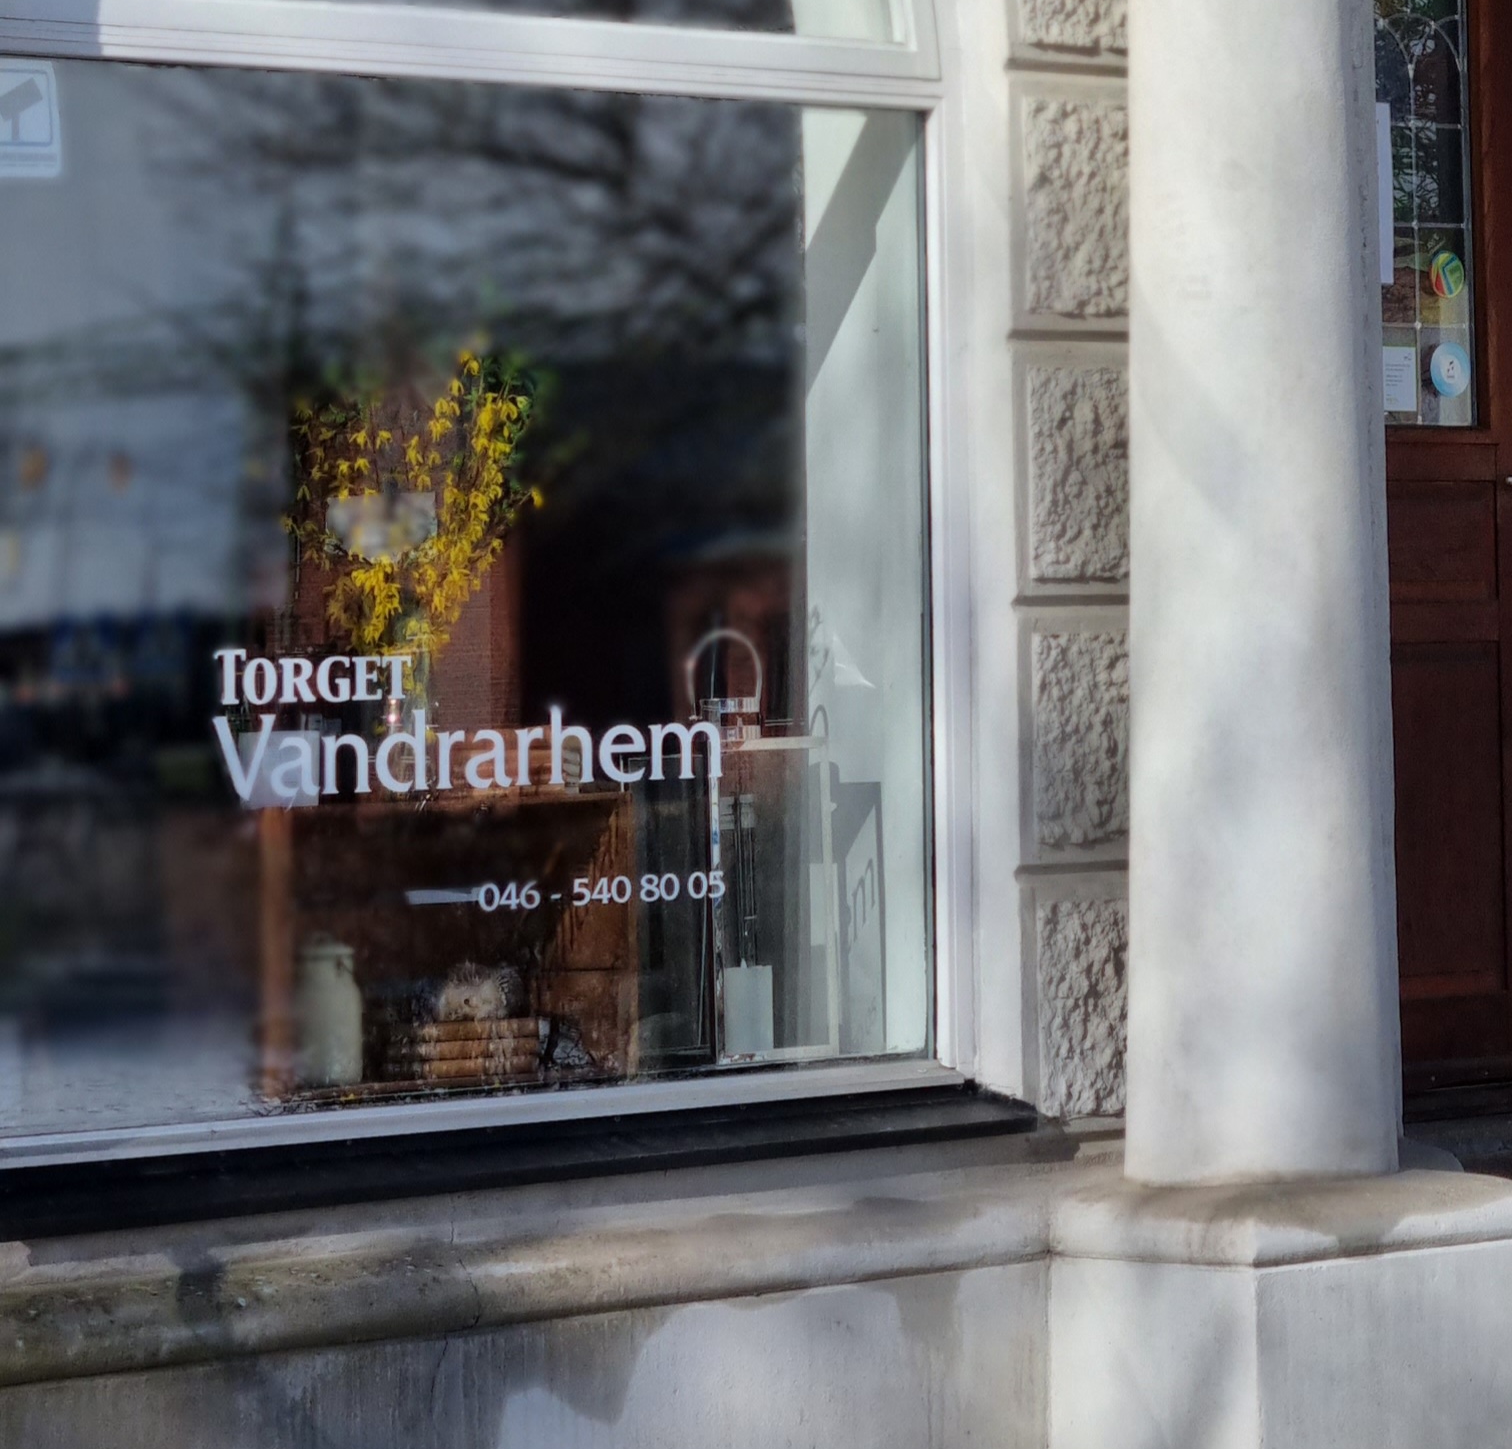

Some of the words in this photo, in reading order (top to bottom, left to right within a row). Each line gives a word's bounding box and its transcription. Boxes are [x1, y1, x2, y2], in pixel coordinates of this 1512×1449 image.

[212, 705, 723, 801] Vandrarhem
[478, 881, 541, 912] 046
[572, 875, 632, 906] 540
[640, 873, 680, 902] 80
[687, 871, 726, 899] 05
